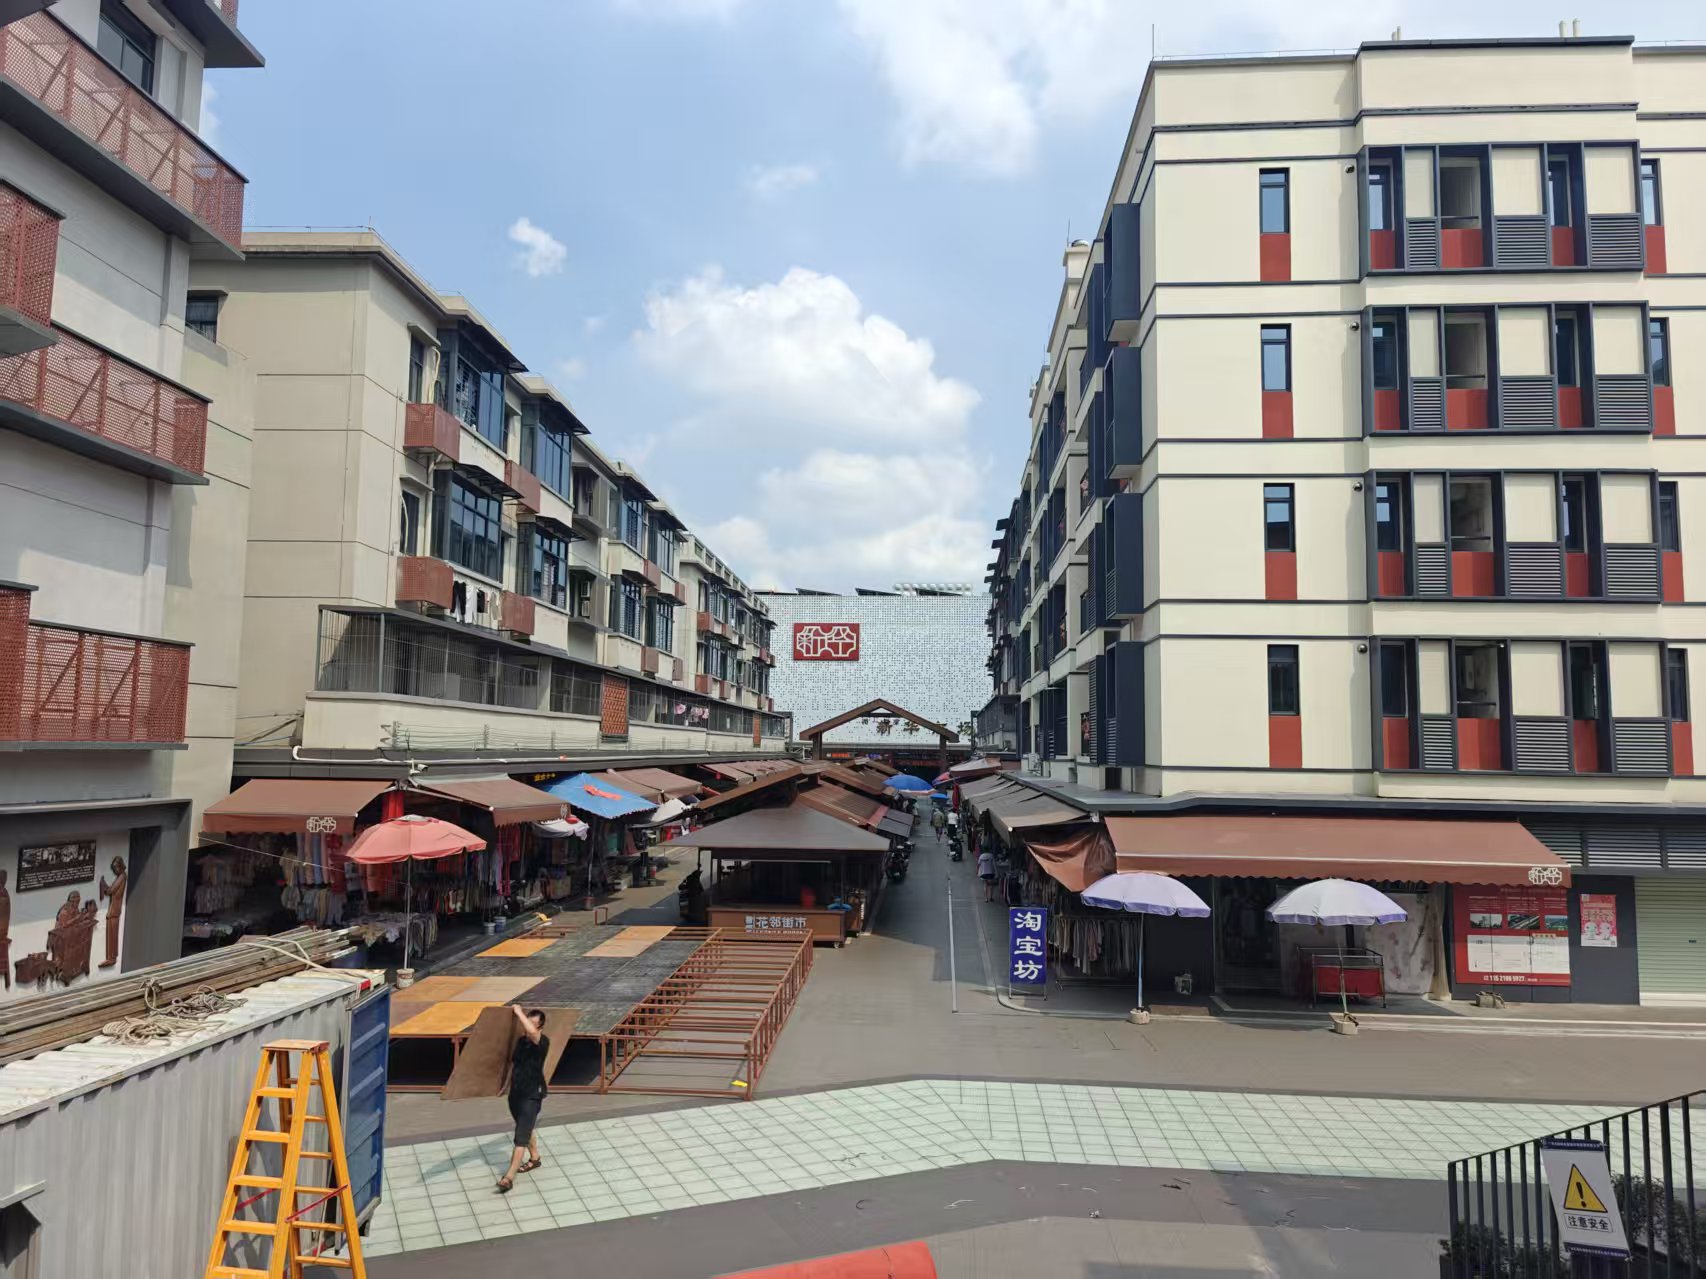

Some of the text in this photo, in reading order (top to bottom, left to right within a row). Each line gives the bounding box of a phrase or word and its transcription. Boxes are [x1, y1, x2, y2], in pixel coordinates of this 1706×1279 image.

[1014, 912, 1043, 980] 淘宝坊
[1567, 1215, 1609, 1231] 注意安全
